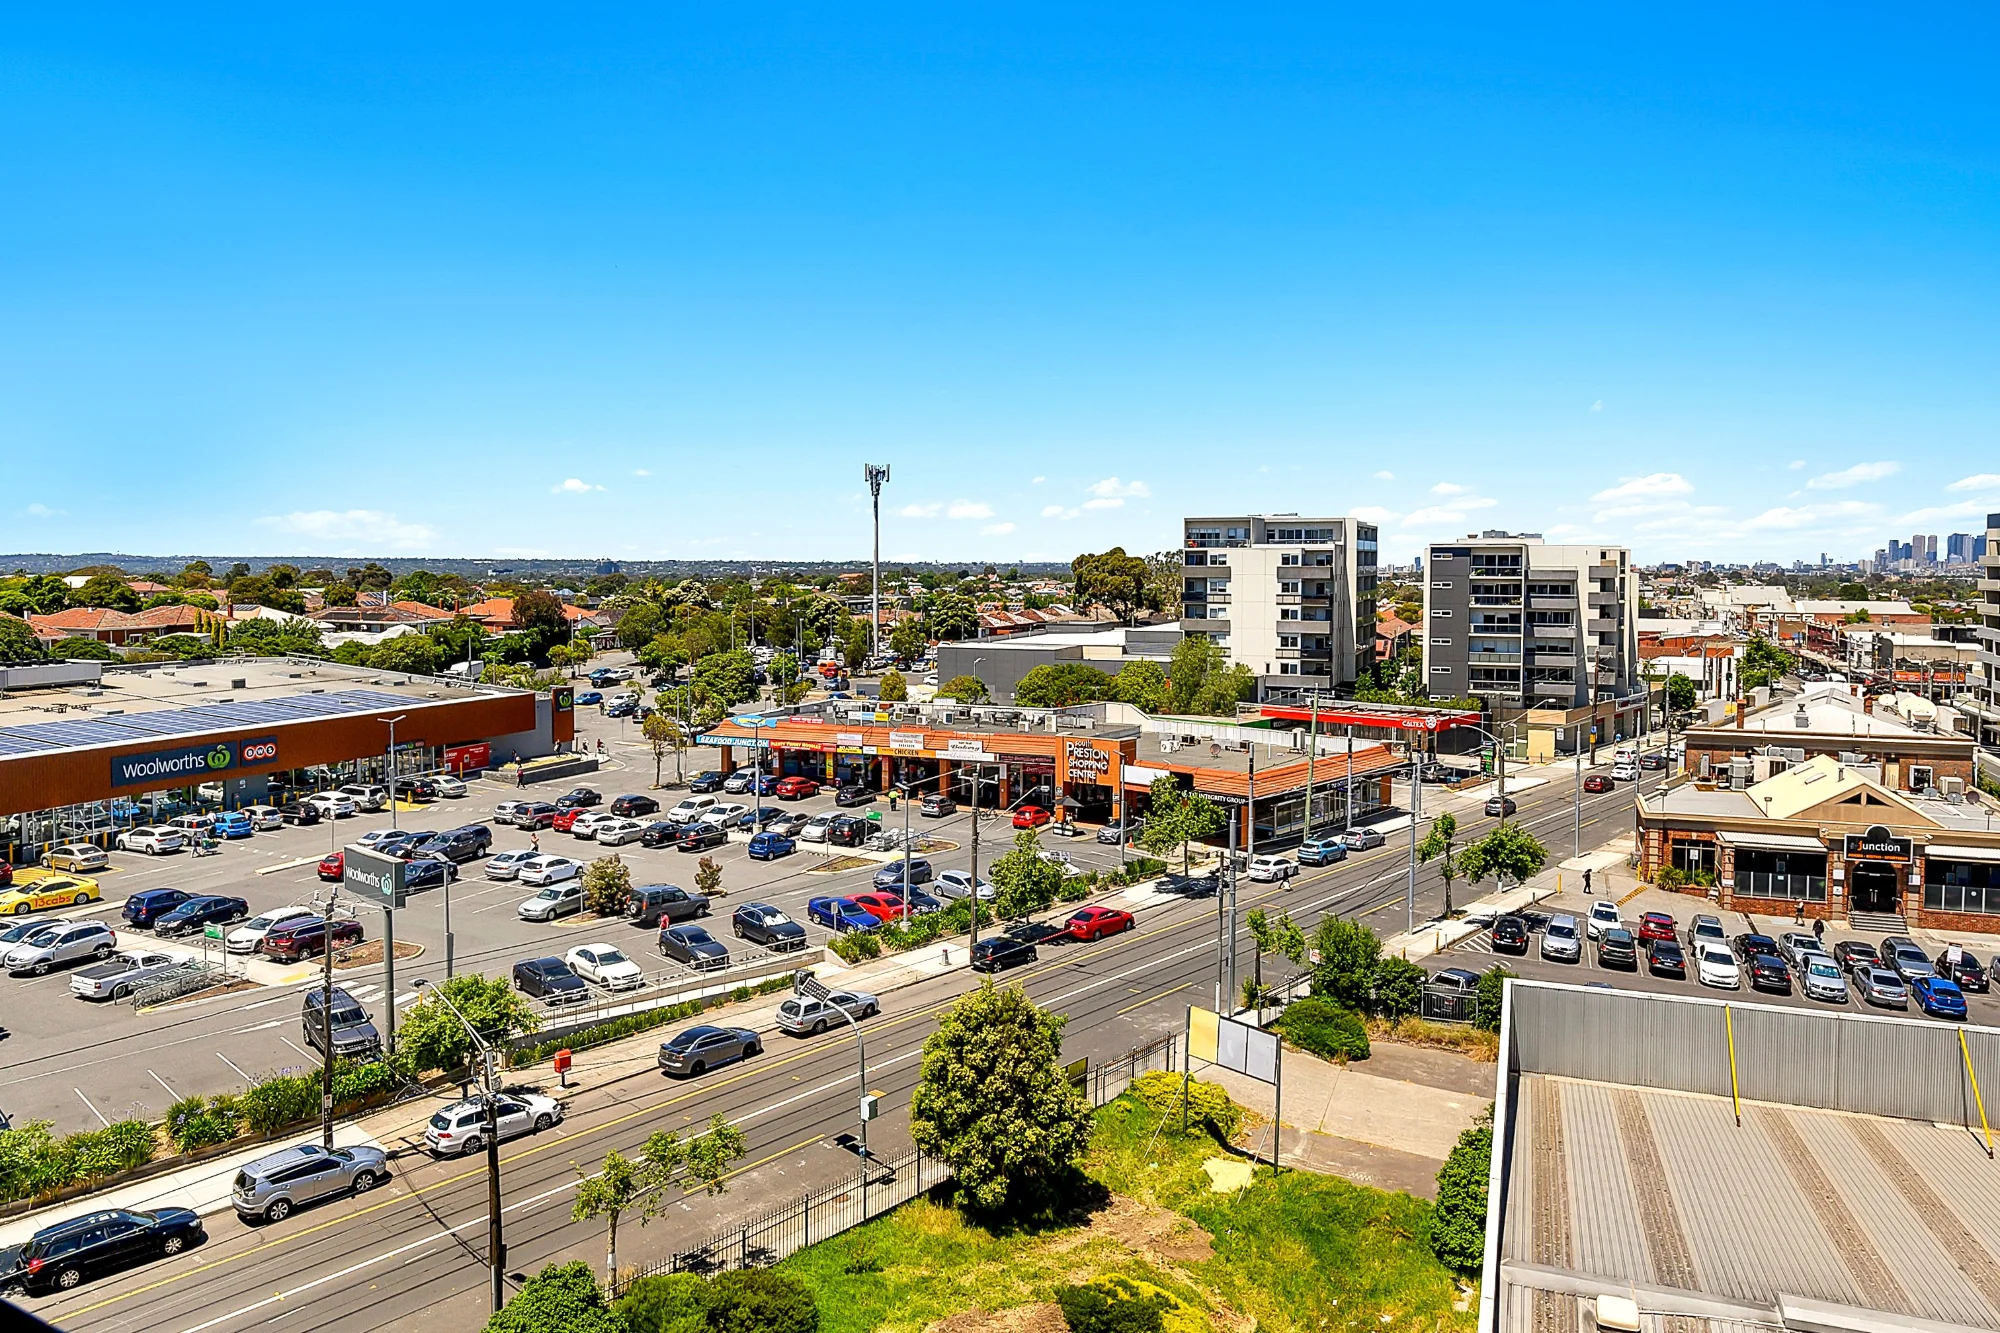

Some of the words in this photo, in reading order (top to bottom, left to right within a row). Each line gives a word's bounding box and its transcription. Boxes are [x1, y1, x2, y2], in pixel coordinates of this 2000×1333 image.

[1402, 720, 1425, 728] CALTEX
[700, 735, 732, 745] SEAFOOD
[246, 745, 274, 759] BWS
[894, 748, 919, 756] CHICKEN
[1066, 741, 1109, 760] PRESTON
[123, 753, 205, 778] Woolworths
[1068, 758, 1108, 770] SHOPPING
[1067, 769, 1096, 779] CENTRE
[34, 894, 71, 908] 13cabs
